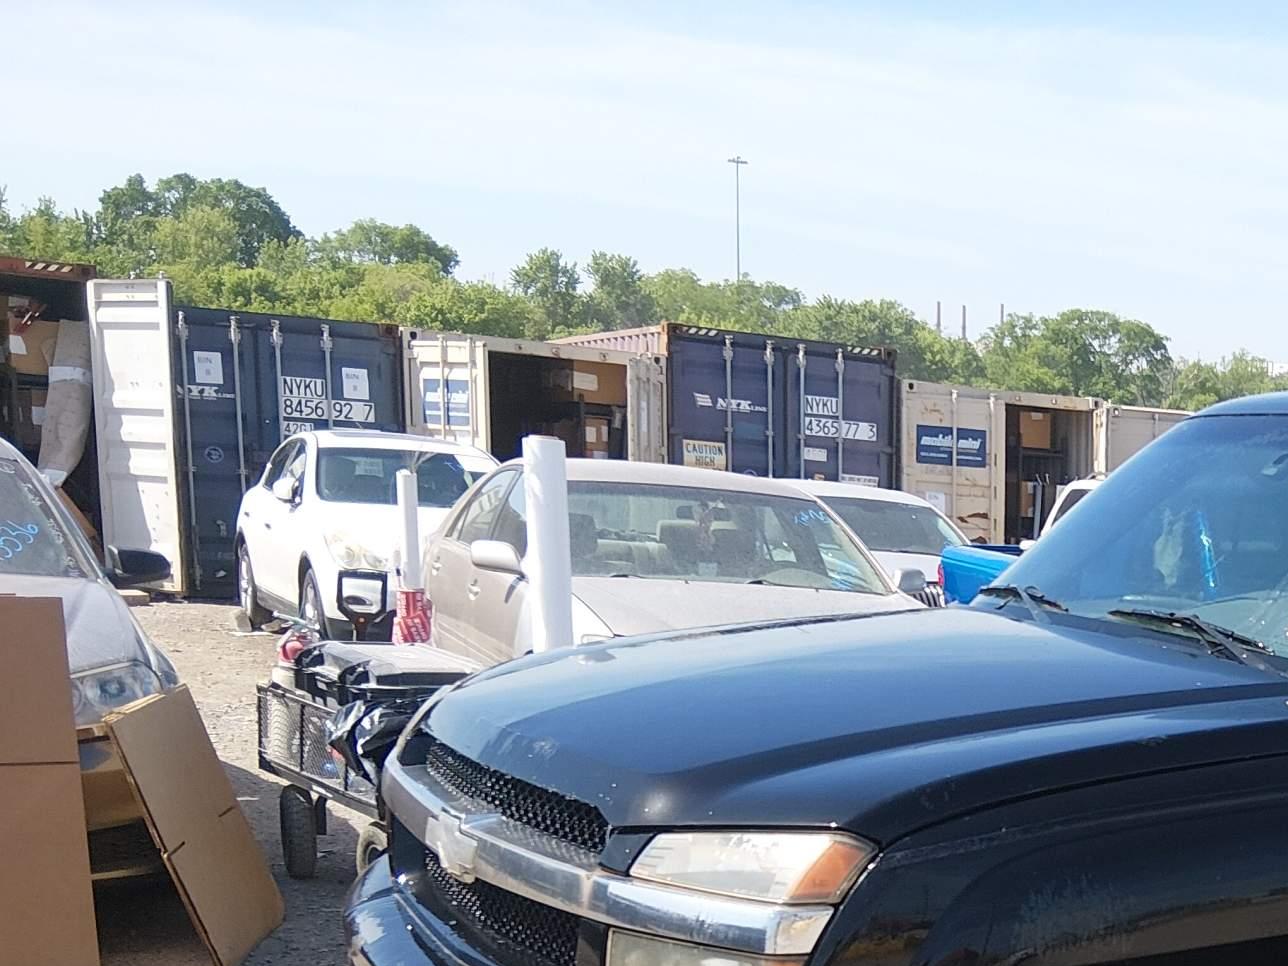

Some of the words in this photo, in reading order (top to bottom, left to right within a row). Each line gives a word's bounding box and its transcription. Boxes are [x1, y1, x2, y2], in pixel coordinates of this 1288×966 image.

[283, 377, 325, 398] NYKU
[362, 403, 374, 421] 7
[805, 397, 839, 415] NYKU
[867, 424, 876, 439] 3
[686, 442, 723, 456] CAUTION
